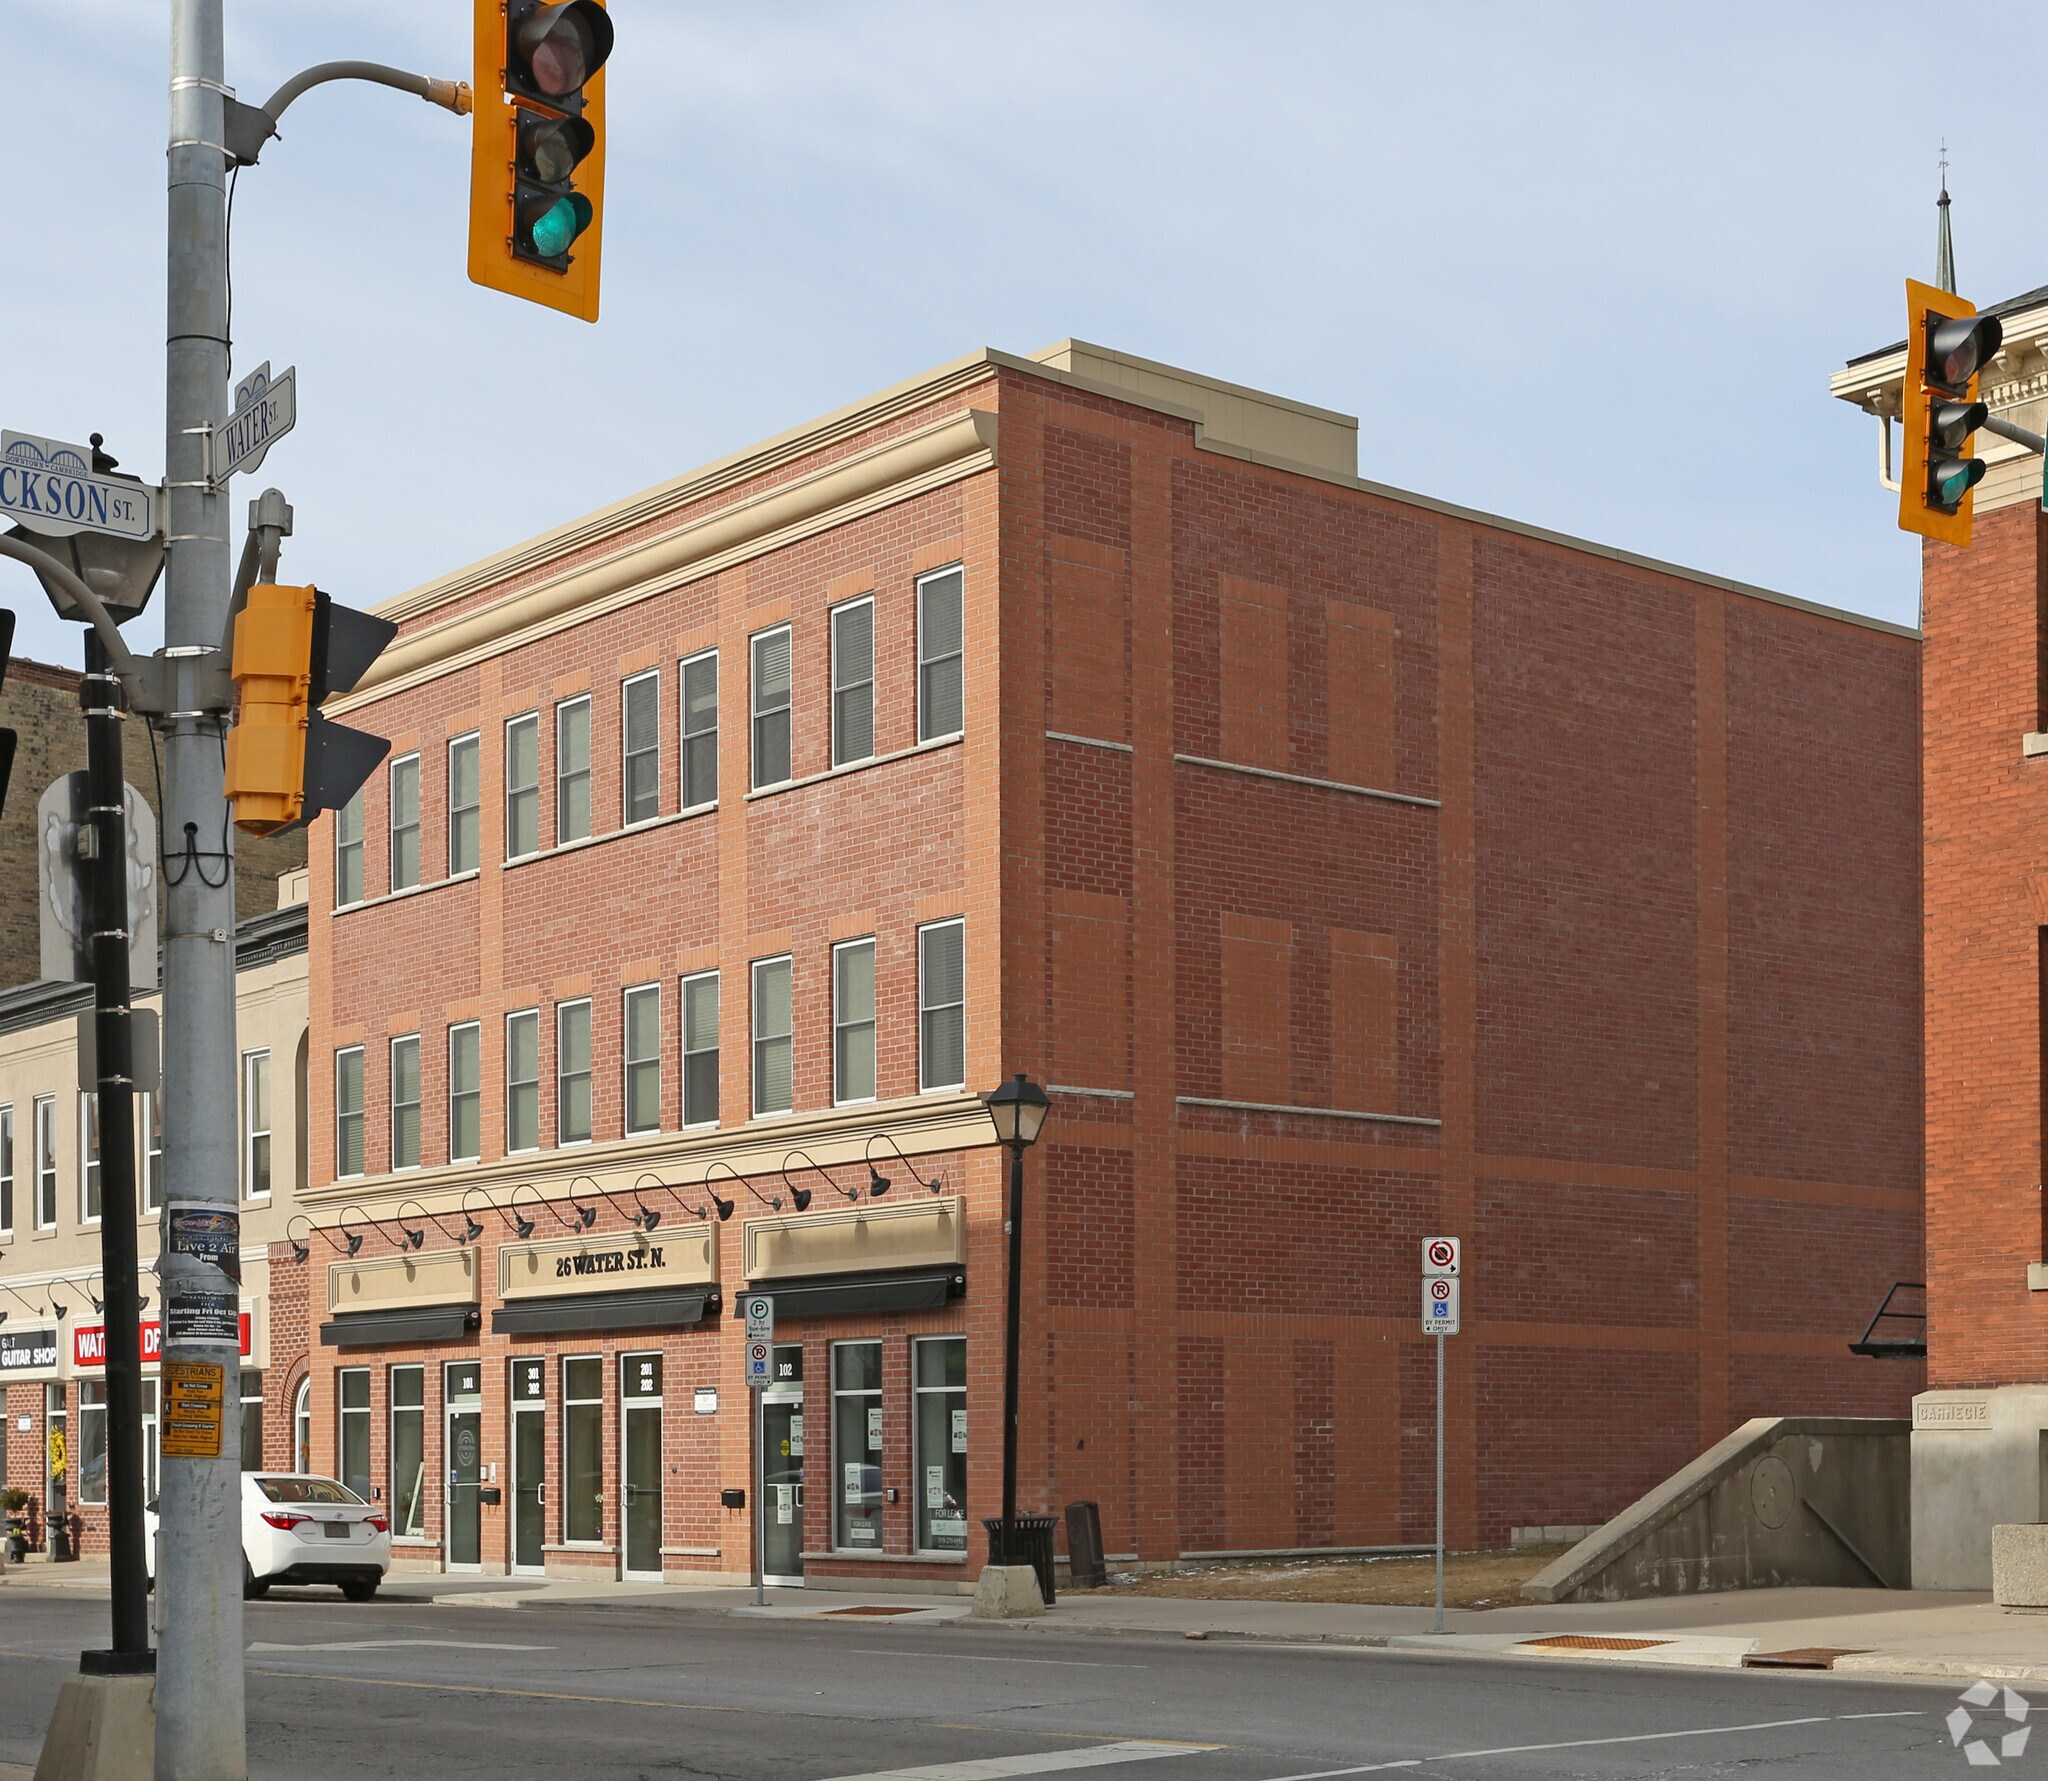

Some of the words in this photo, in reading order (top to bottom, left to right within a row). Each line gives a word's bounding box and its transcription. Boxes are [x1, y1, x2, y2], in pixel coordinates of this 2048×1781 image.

[226, 400, 269, 466] WATER
[268, 401, 279, 425] ST.
[5, 454, 45, 469] DOWNTOWN
[50, 464, 89, 479] CAMBRIDGE
[0, 466, 109, 525] CKSON
[112, 499, 135, 522] ST.
[177, 1240, 206, 1252] Live
[208, 1243, 218, 1252] 2
[220, 1242, 236, 1254] Air
[199, 1253, 219, 1261] From
[556, 1257, 572, 1277] 26
[572, 1251, 625, 1275] WATER
[627, 1248, 648, 1270] ST.
[650, 1247, 666, 1268] N.
[169, 1308, 201, 1316] Starting
[78, 1332, 106, 1358] WAT
[2, 1348, 31, 1367] GUITAR
[33, 1346, 56, 1365] SHOP
[528, 1367, 540, 1380] 301
[640, 1363, 653, 1376] 201
[779, 1363, 793, 1377] 102
[463, 1377, 474, 1390] 101
[528, 1382, 540, 1395] 302
[640, 1379, 653, 1392] 202
[1920, 1406, 1987, 1421] CARNEGIE
[935, 1509, 947, 1518] FOR
[947, 1509, 965, 1518] LEASE
